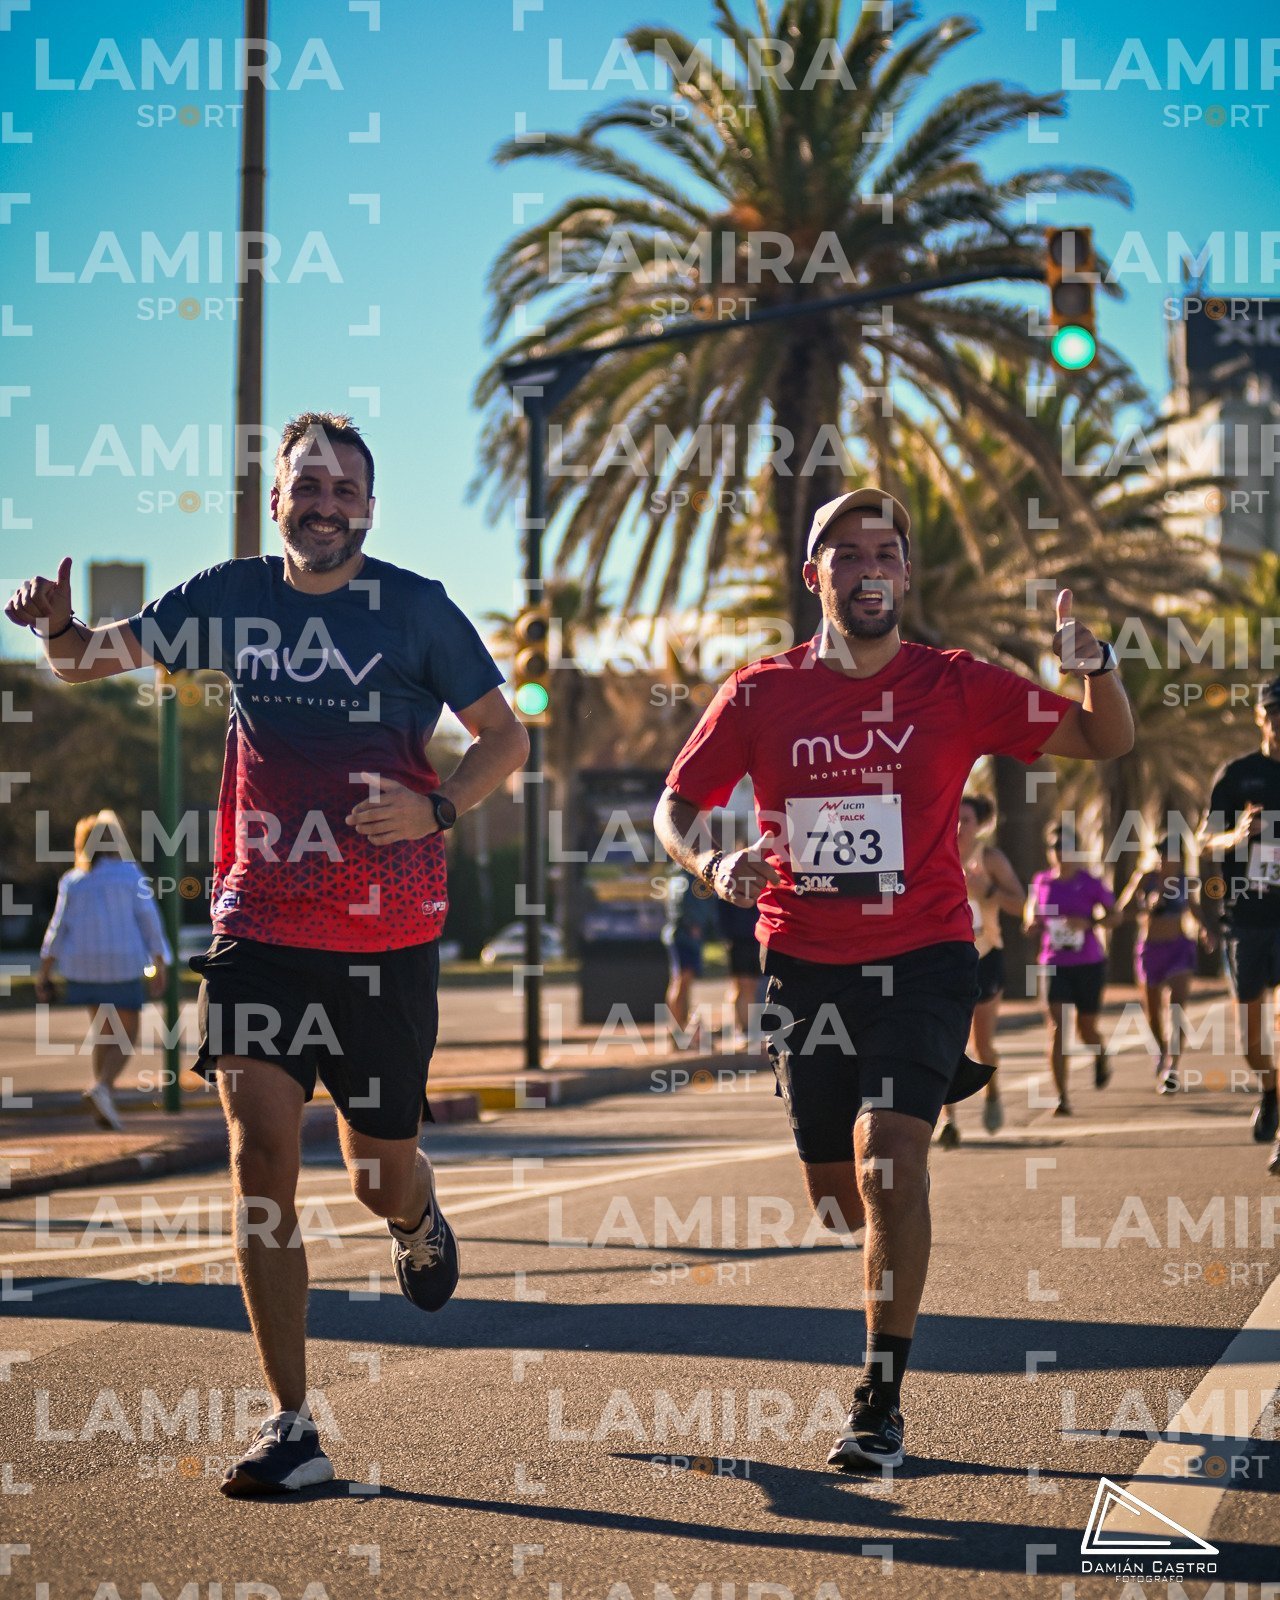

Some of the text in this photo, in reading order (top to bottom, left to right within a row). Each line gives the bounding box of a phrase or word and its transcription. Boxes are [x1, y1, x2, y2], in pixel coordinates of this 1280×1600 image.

[251, 694, 360, 708] MONTEVIDEO
[810, 763, 903, 781] MONTEVIDEO
[842, 802, 865, 811] ucm
[840, 814, 865, 822] FALCK
[806, 829, 883, 867] 783
[800, 875, 835, 892] 30K
